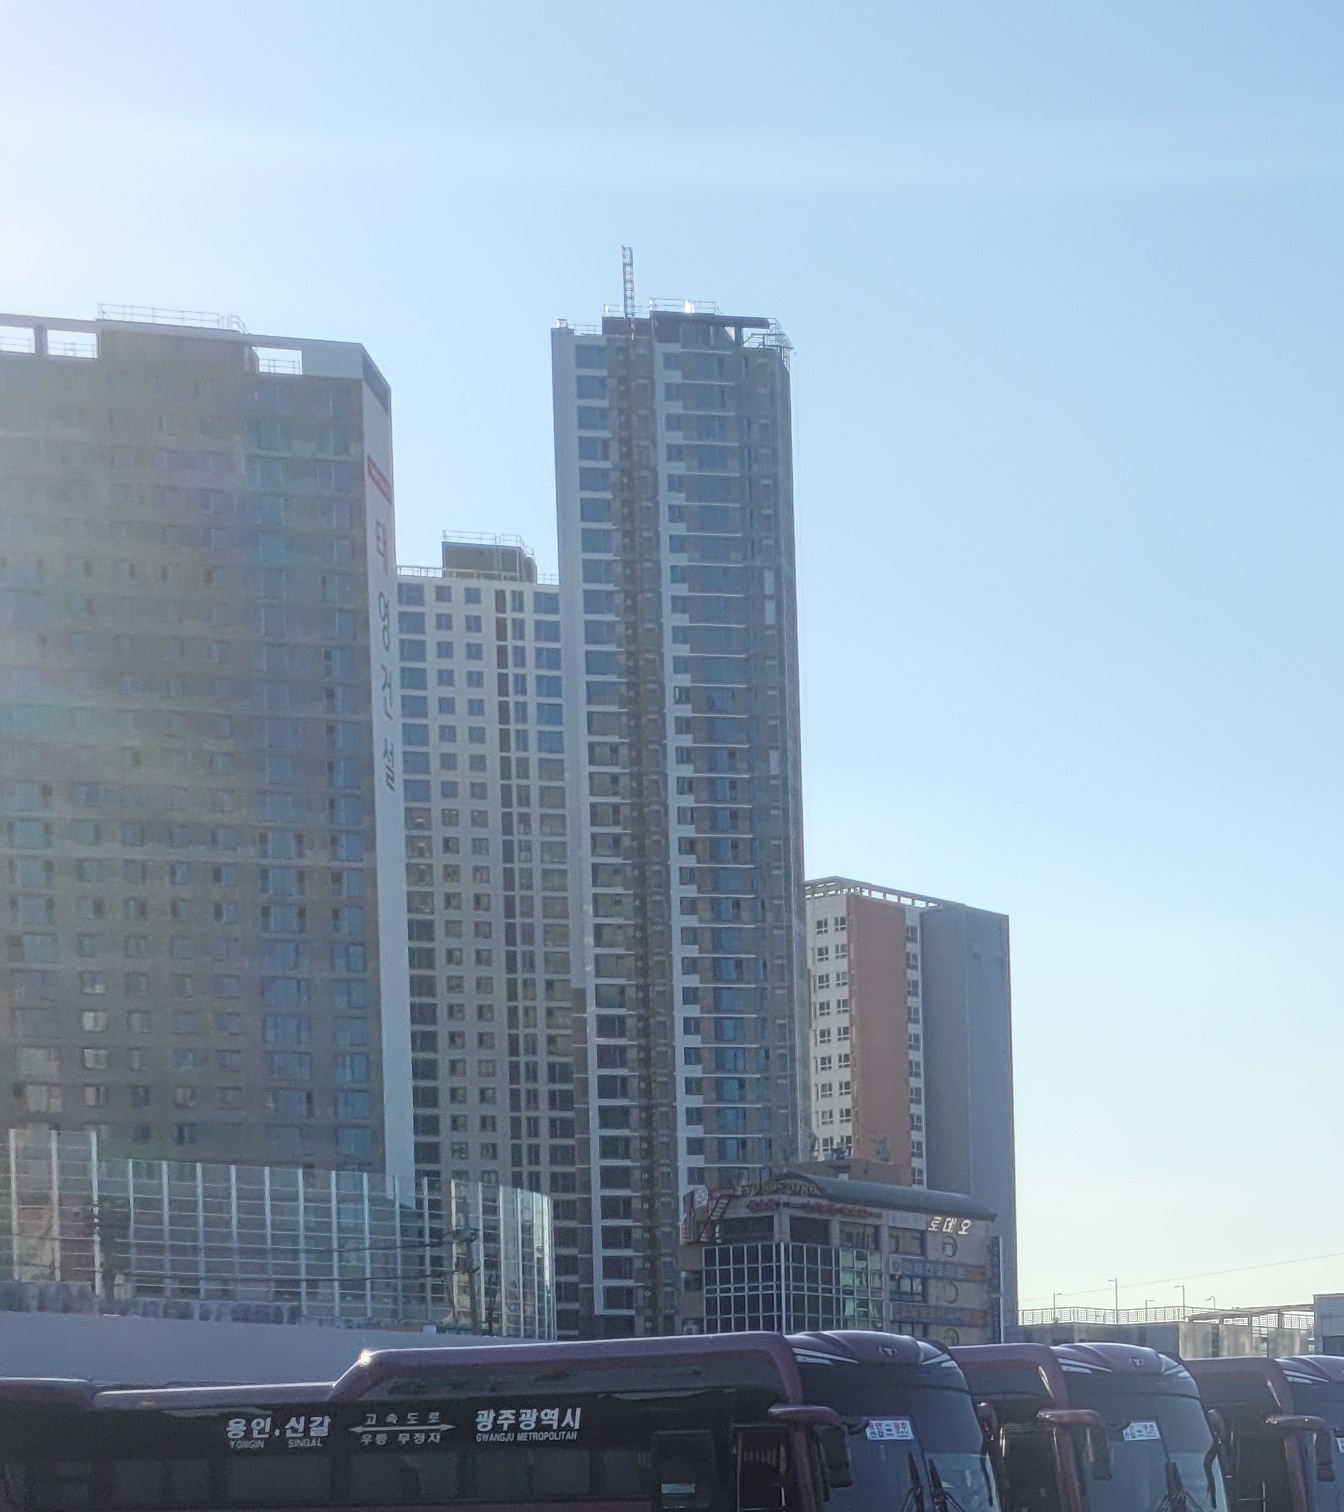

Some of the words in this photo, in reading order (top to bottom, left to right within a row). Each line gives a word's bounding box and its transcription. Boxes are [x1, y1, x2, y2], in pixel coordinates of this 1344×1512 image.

[927, 1216, 973, 1236] 로데오
[474, 1407, 582, 1432] 광주광역시
[229, 1439, 265, 1449] YONGIN
[287, 1438, 323, 1449] SINGAL
[476, 1432, 515, 1443] GWANGJU
[516, 1431, 577, 1442] METROPOLITAN
